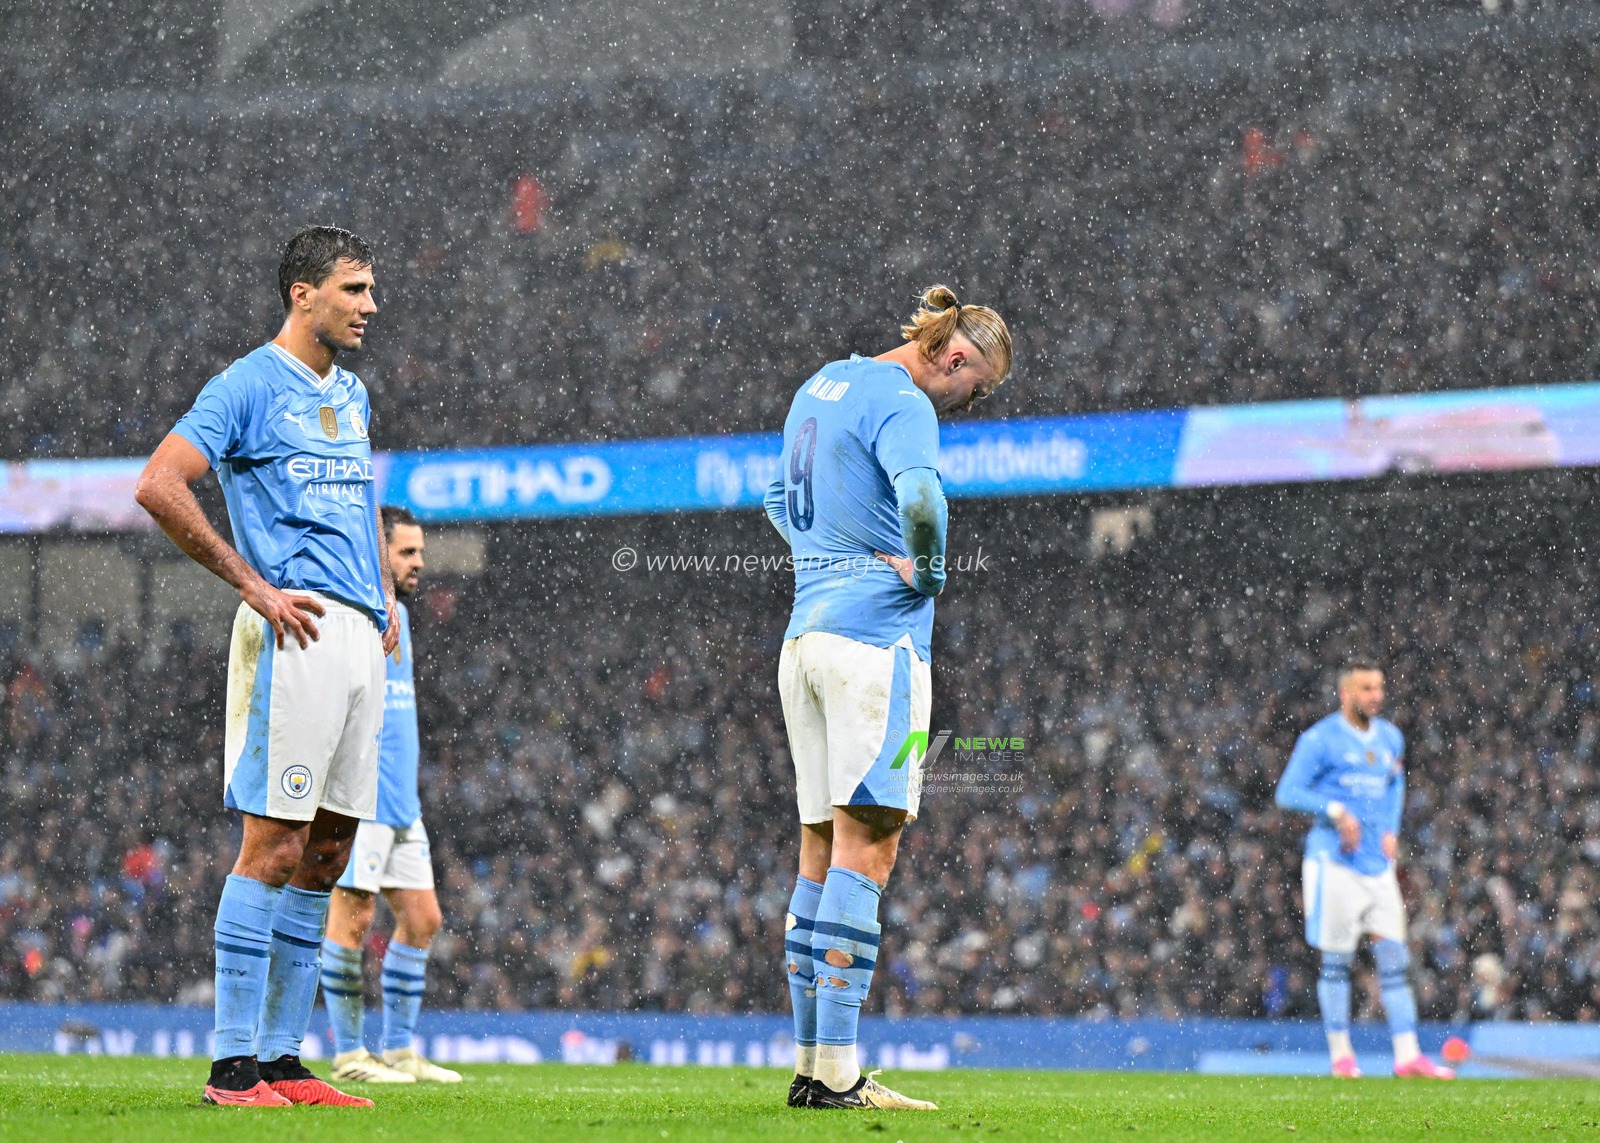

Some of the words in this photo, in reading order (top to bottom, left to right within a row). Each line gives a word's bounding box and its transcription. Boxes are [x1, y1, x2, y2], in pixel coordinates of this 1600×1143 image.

[305, 483, 363, 498] AIRWAYS
[407, 456, 612, 507] ETIHAD
[787, 416, 818, 532] 9
